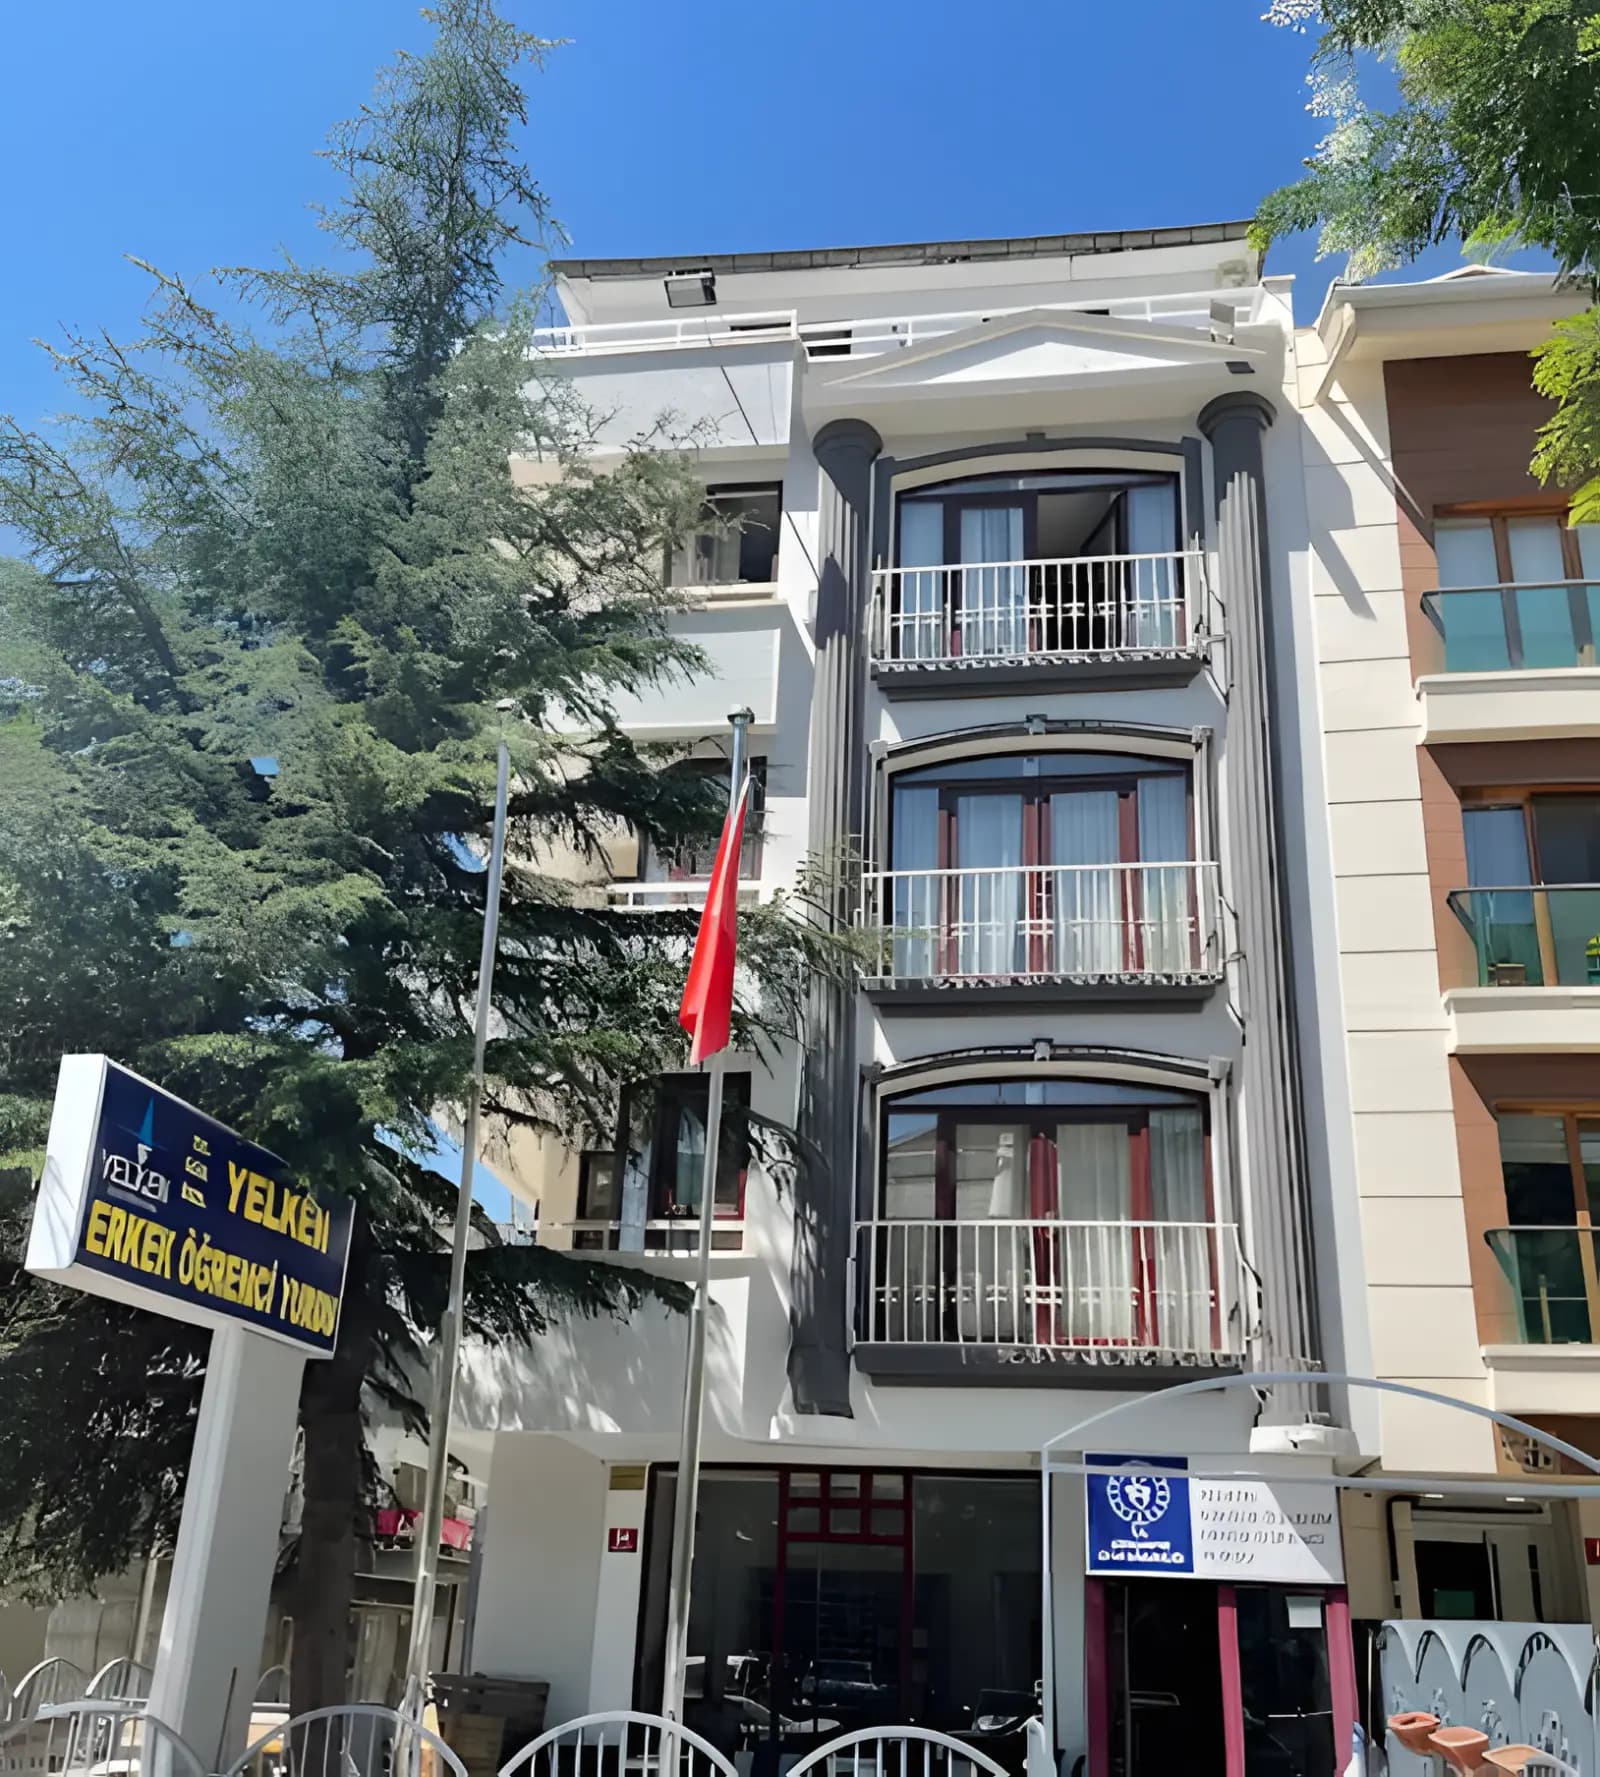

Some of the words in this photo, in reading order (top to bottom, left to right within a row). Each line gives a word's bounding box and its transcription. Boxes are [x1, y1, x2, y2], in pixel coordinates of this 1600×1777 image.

[227, 1159, 331, 1254] YELKEN
[85, 1199, 176, 1280] ERKEK
[178, 1227, 278, 1314] ÖĞRENCİ
[279, 1273, 340, 1337] YURDU
